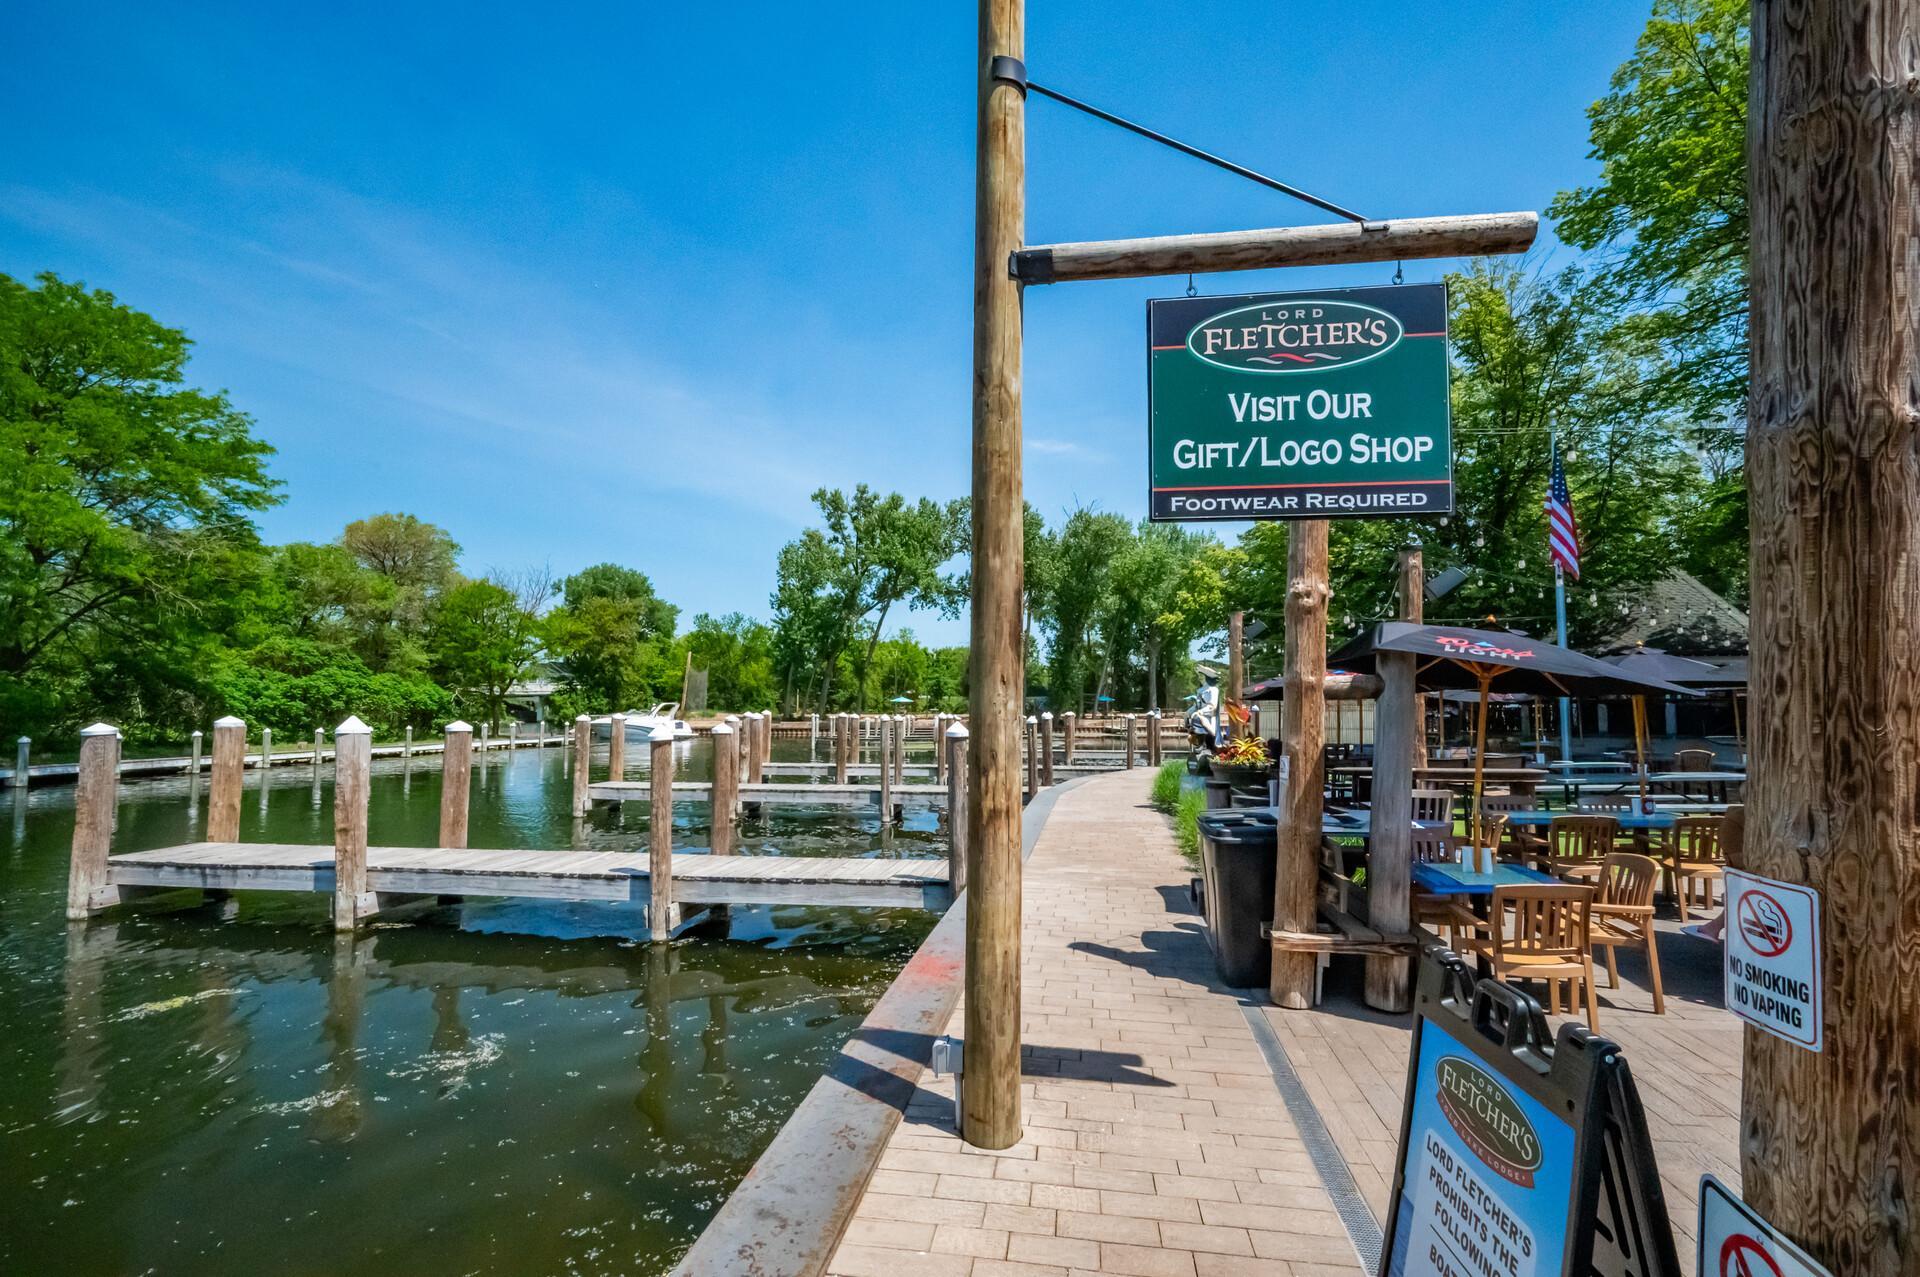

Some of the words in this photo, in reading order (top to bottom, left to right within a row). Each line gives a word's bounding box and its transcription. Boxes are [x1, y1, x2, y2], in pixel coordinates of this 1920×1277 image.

[1262, 308, 1324, 321] LORD
[1203, 318, 1388, 355] FLETCHER'S
[1228, 392, 1301, 423] VISIT
[1306, 389, 1373, 420] OUR
[1173, 436, 1343, 470] GIFT/LOGO
[1349, 432, 1434, 464] SHOP
[1171, 496, 1298, 512] FOOTWEAR
[1305, 493, 1428, 511] REQUIRED
[1729, 954, 1743, 978] NO
[1744, 962, 1810, 1005] SMOKING
[1734, 982, 1749, 1006] NO
[1750, 989, 1802, 1030] VAPING
[1471, 1071, 1502, 1100] LORD
[1441, 1063, 1533, 1161] FLETCHER'S
[1487, 1156, 1521, 1181] LODGE
[1426, 1134, 1454, 1174] LORD
[1456, 1165, 1532, 1258] FLETCHER'S
[1429, 1165, 1489, 1243] PROHIBITS
[1491, 1233, 1519, 1277] THE
